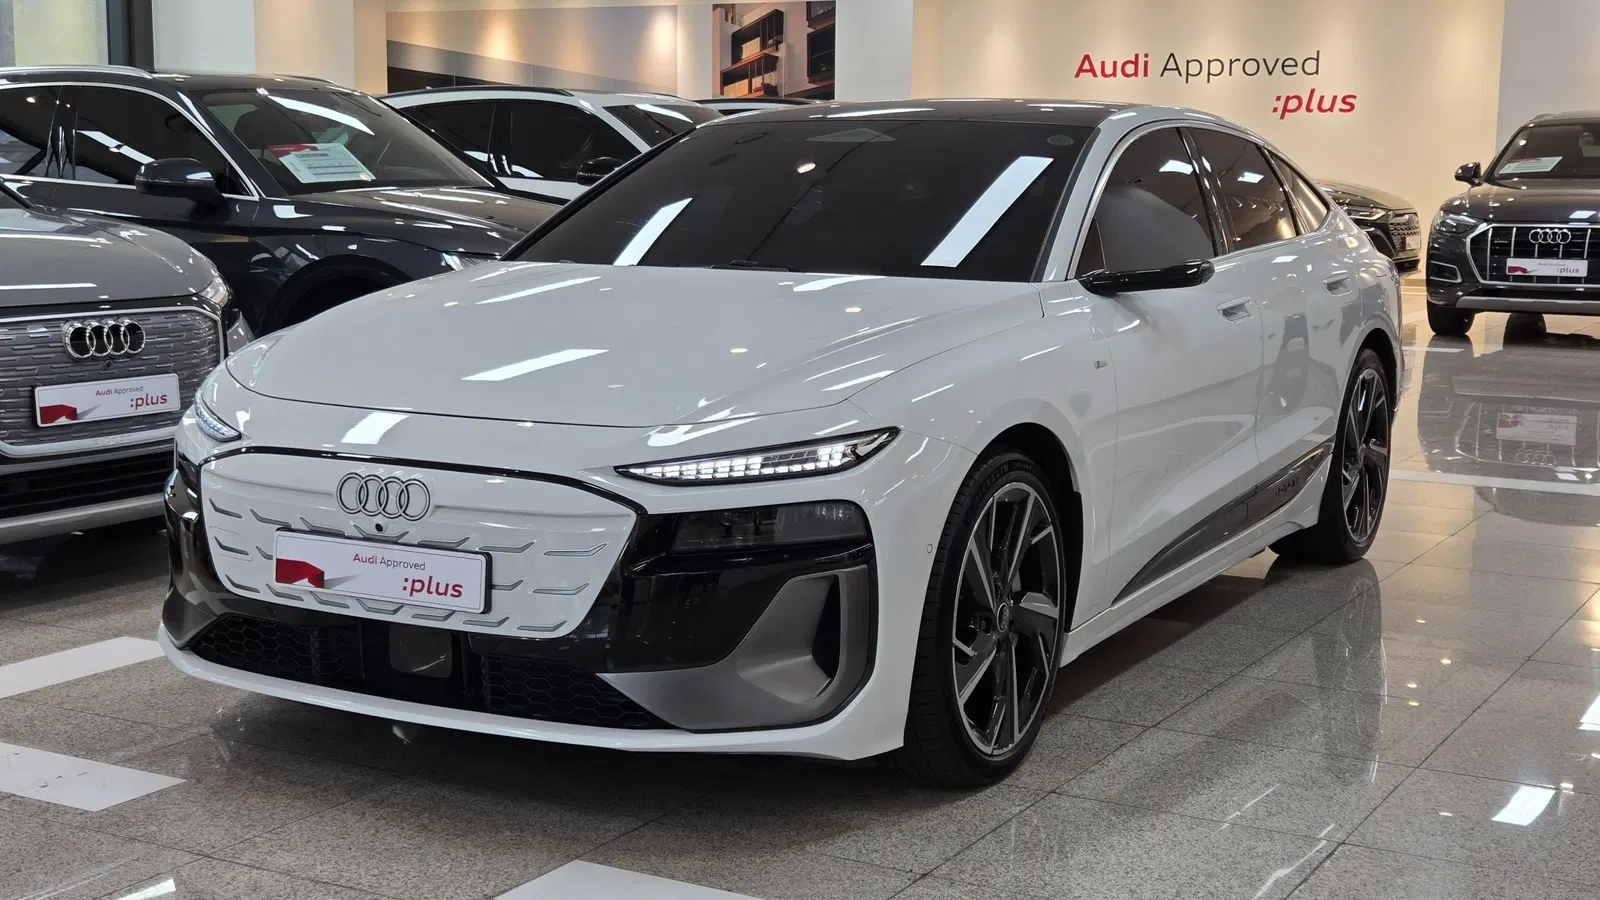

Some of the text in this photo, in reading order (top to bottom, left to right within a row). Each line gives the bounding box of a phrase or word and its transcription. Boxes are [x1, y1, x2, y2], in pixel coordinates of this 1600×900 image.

[1074, 50, 1320, 84] Audi Approved
[1271, 88, 1357, 120] :plus
[95, 386, 144, 397] Audi Approved
[130, 393, 168, 410] :plus
[353, 553, 426, 571] Audi Approved
[402, 576, 464, 598] :plus
